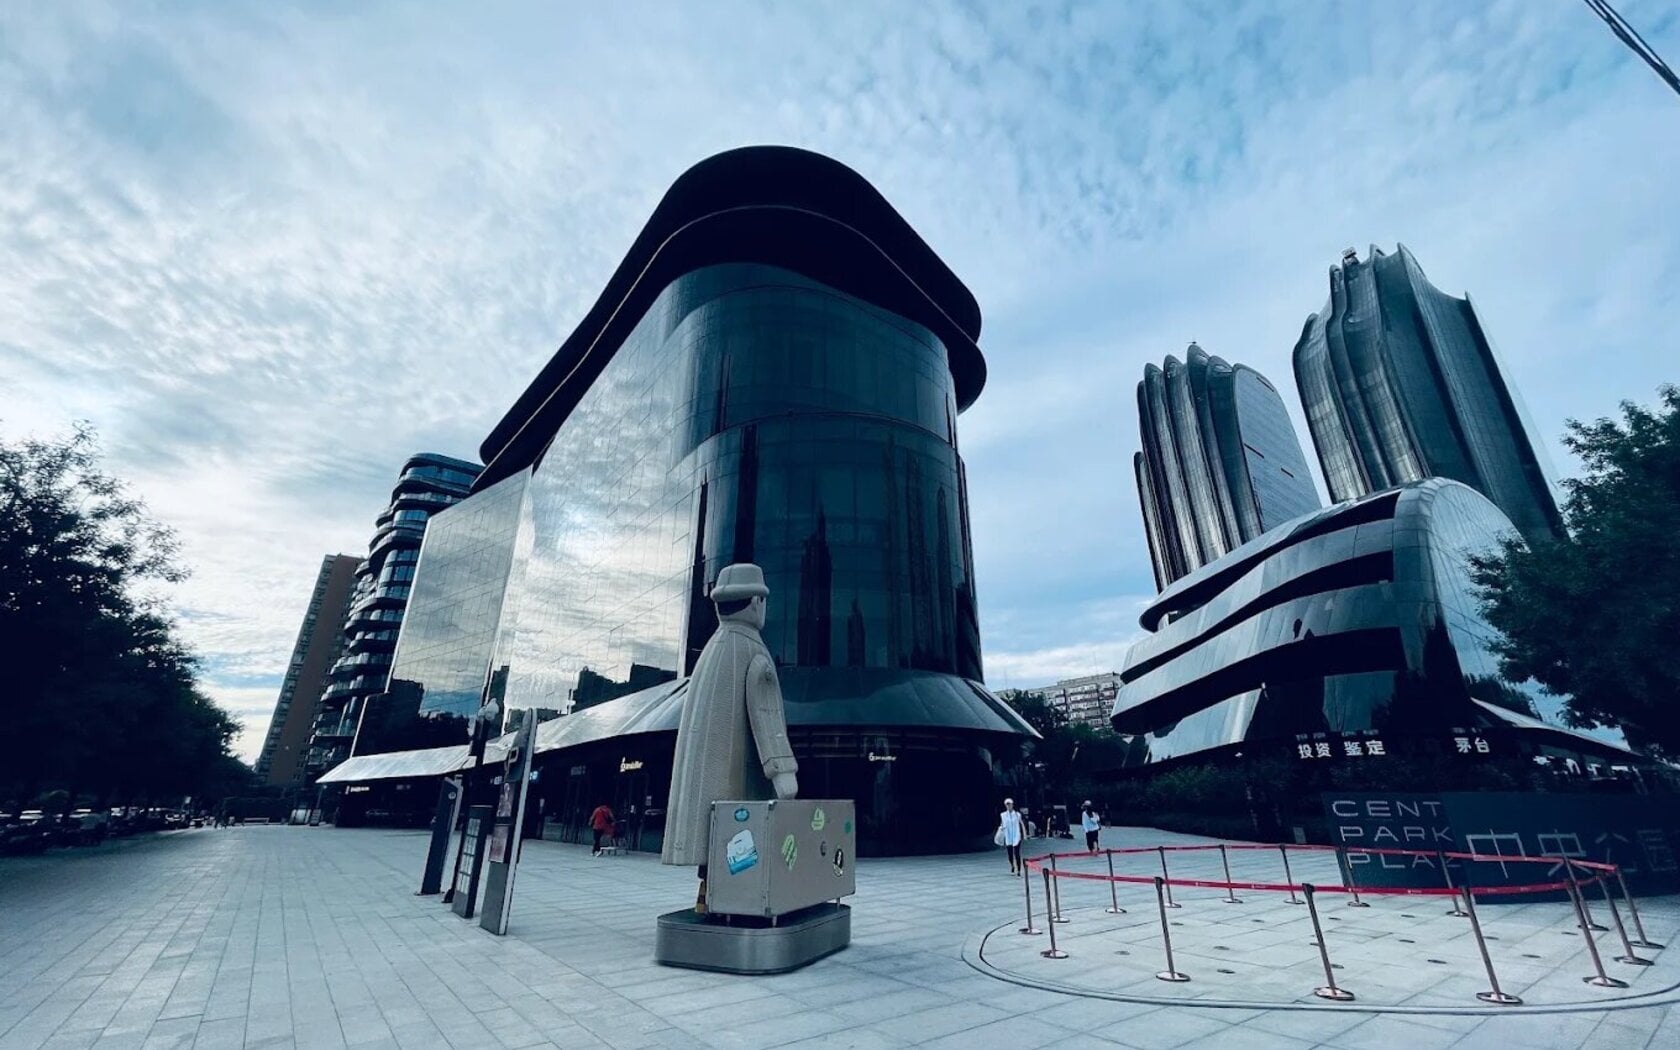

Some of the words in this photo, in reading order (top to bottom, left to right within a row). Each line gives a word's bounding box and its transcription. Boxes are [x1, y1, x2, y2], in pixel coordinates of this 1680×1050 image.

[1298, 742, 1332, 759] 投资
[1344, 740, 1386, 756] 鉴定
[1454, 737, 1490, 753] 茅台
[1332, 800, 1441, 817] CENT
[1340, 826, 1454, 842] PARK
